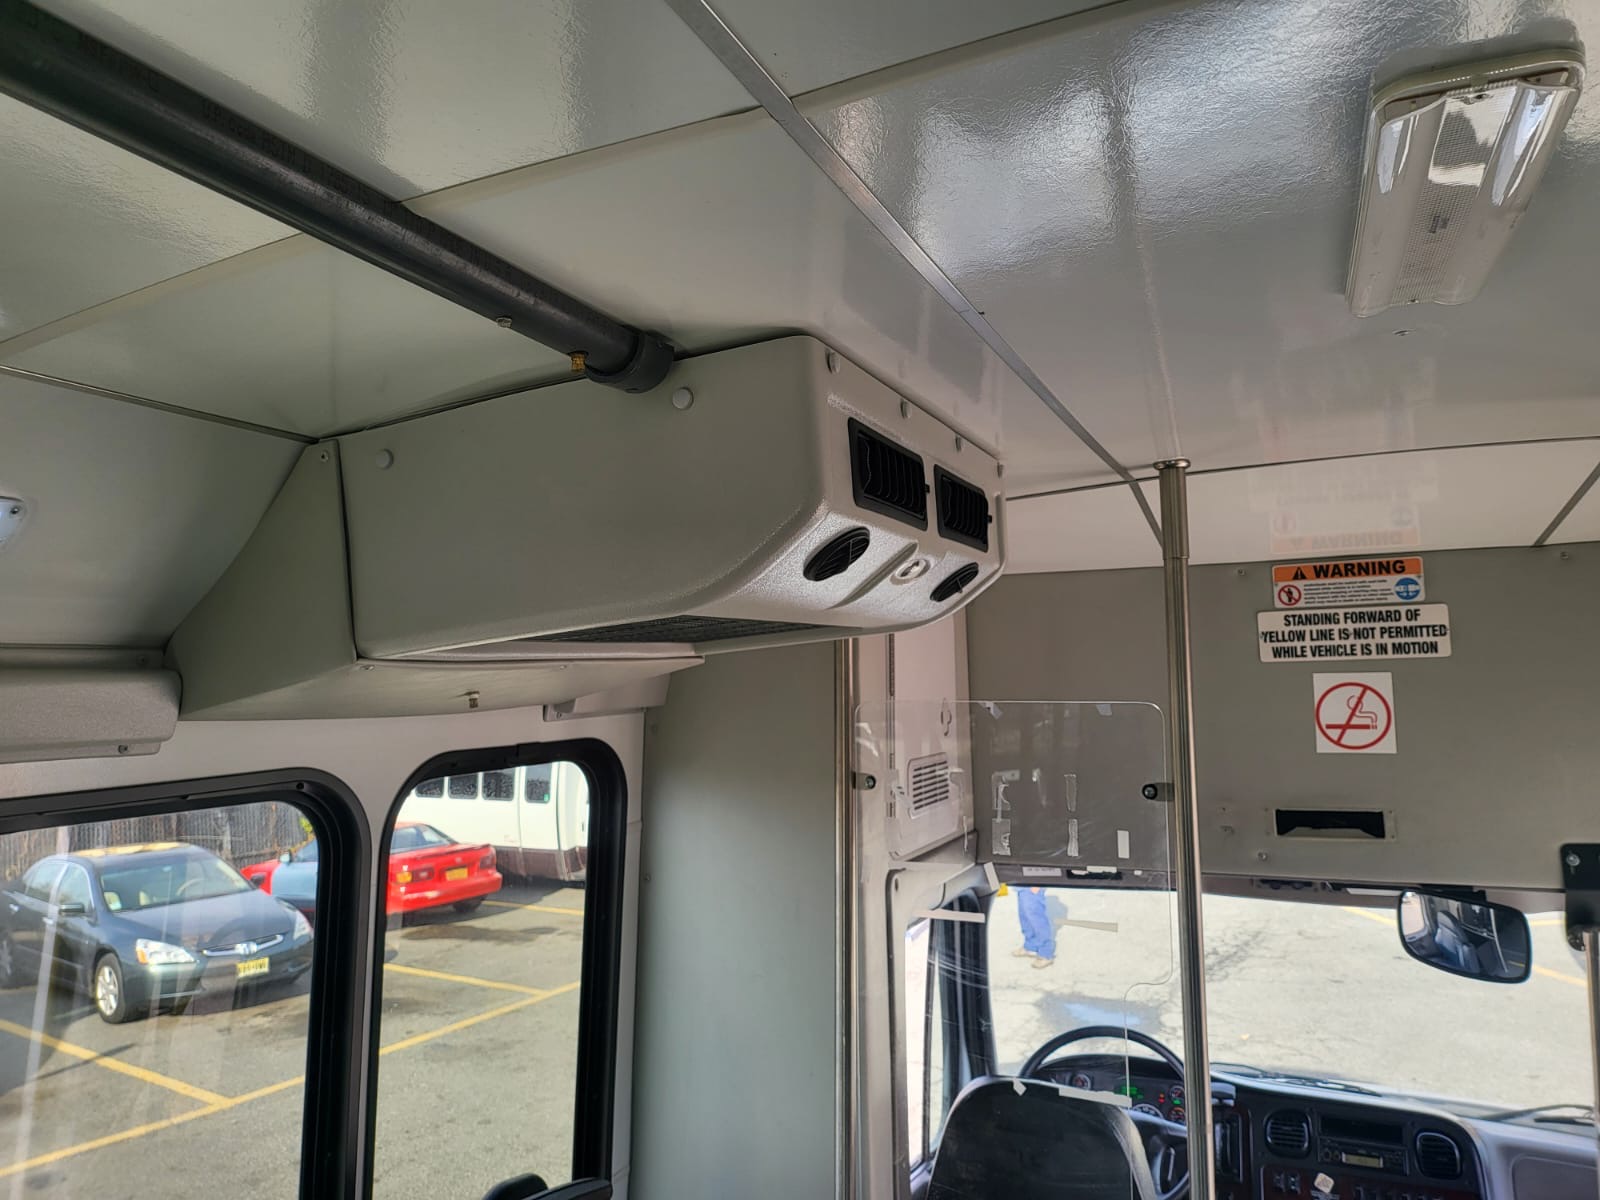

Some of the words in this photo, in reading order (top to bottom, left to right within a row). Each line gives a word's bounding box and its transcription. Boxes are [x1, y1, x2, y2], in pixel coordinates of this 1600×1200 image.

[1312, 559, 1406, 578] WARNING
[1284, 612, 1340, 626] STANDING
[1344, 610, 1401, 624] FORWARD
[1406, 609, 1421, 621] OF
[1261, 629, 1306, 643] YELLOW
[1309, 628, 1335, 642] LINE
[1338, 628, 1349, 640] IS
[1353, 627, 1376, 640] NOT
[1380, 624, 1447, 639] PERMITTED
[1272, 645, 1307, 659] WHILE
[1310, 644, 1357, 658] VEHICLE
[1360, 643, 1372, 656] IS
[1376, 642, 1388, 655] IN
[1392, 641, 1438, 655] MOTION
